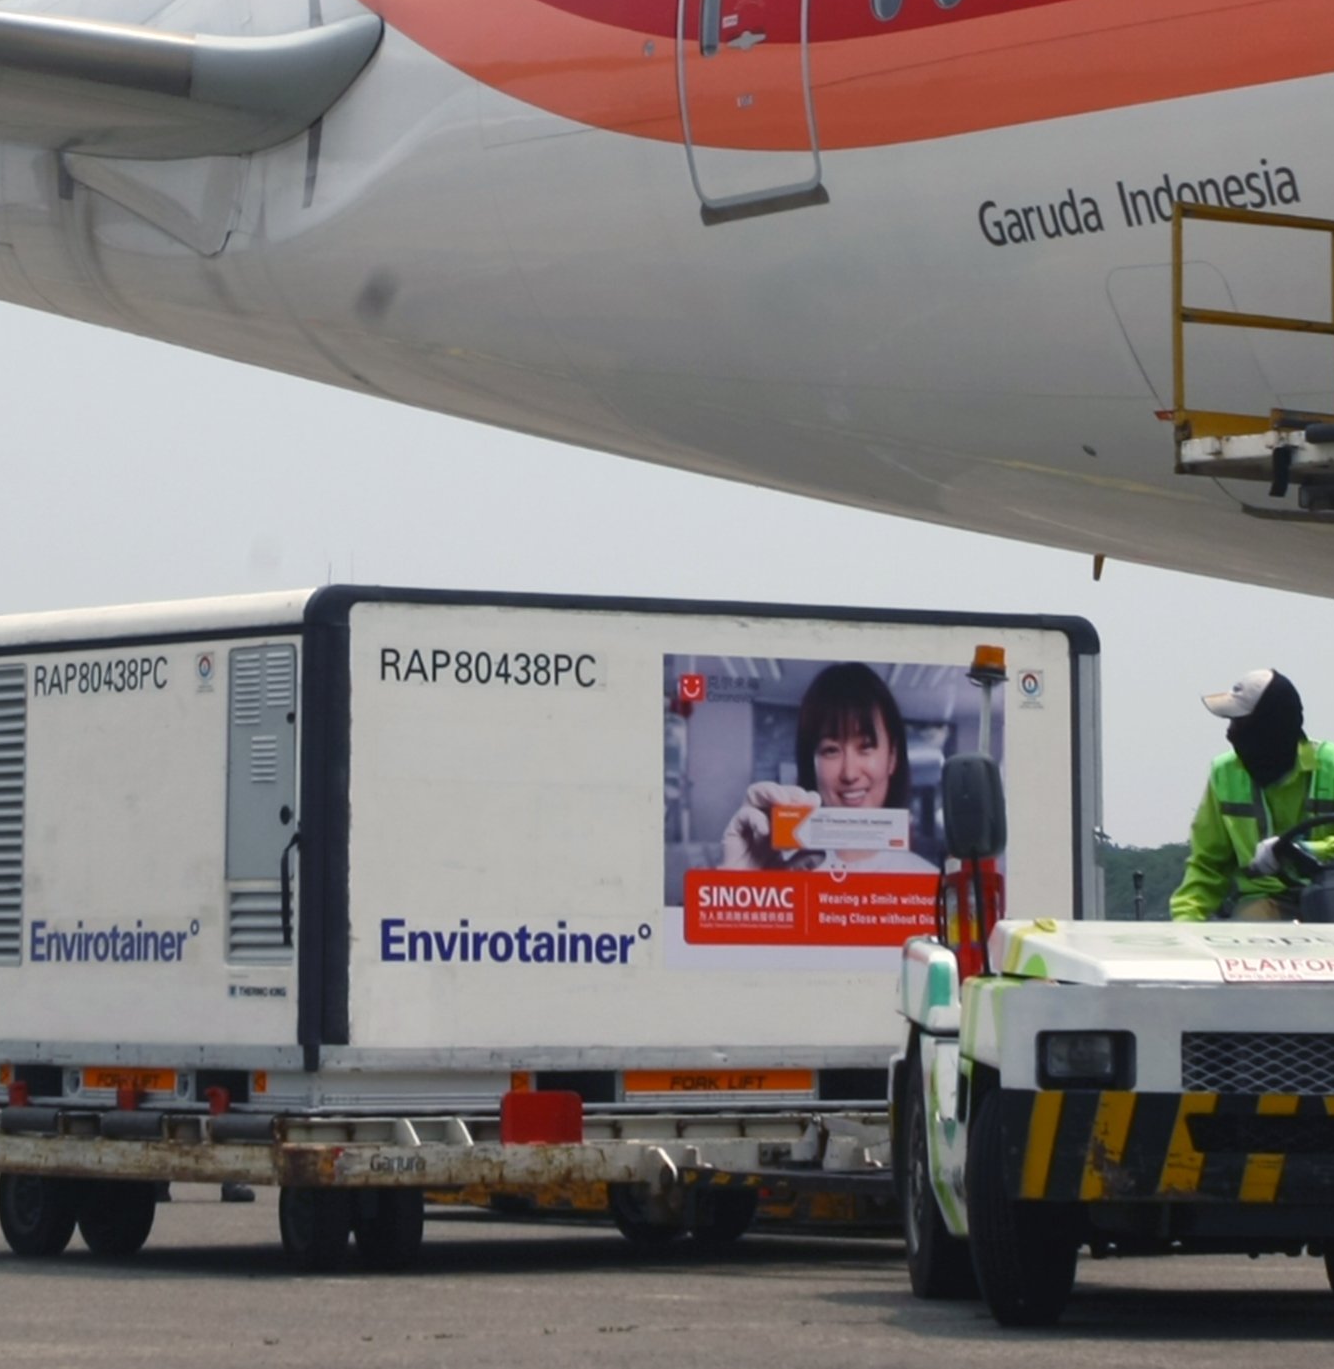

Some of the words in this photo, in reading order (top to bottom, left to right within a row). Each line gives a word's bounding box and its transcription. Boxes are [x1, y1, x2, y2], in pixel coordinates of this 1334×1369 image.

[977, 187, 1105, 247] Garuda
[1115, 157, 1301, 228] Indonesia
[33, 655, 169, 697] RAP80438PC
[380, 647, 597, 688] RAP80438PC
[698, 885, 795, 909] SINOVAC
[818, 893, 860, 907] Wearing
[861, 896, 869, 905] a
[870, 893, 899, 905] Smile
[818, 912, 848, 927] Being
[849, 912, 878, 925] Close
[879, 914, 917, 926] without
[669, 1075, 721, 1090] FORK
[727, 1075, 767, 1090] LIFT
